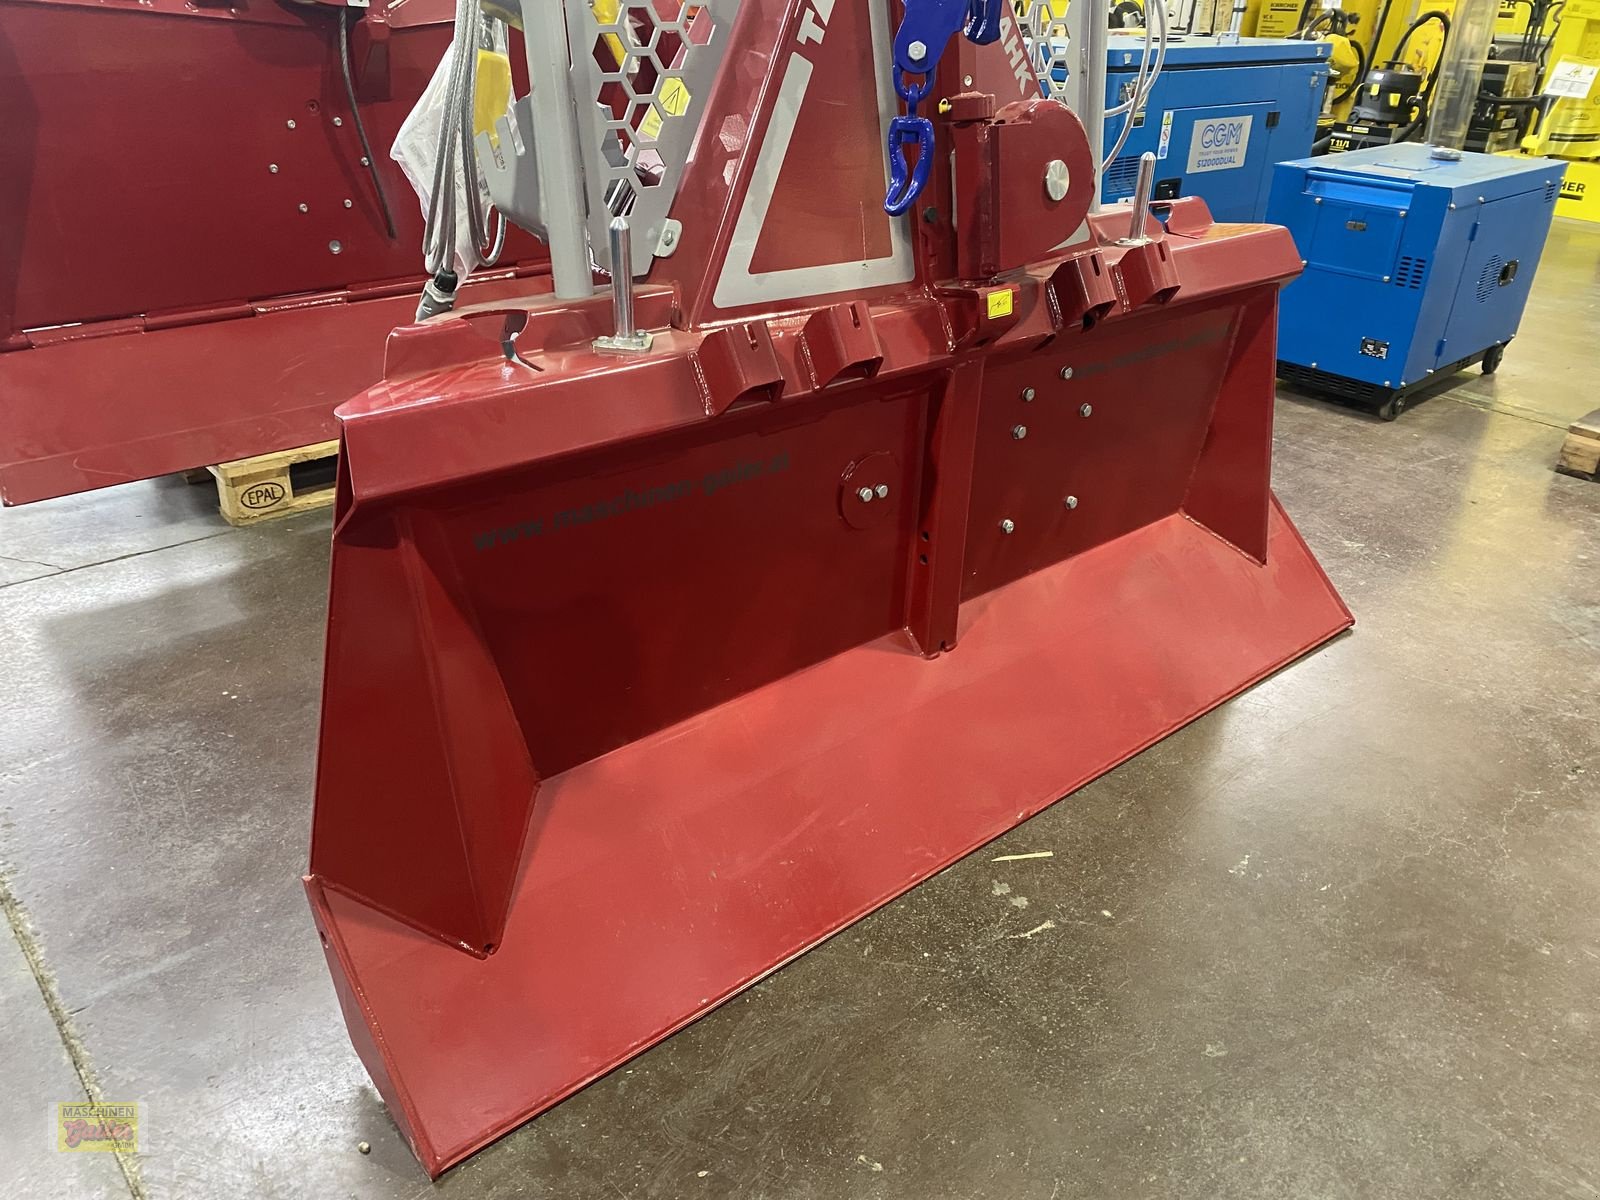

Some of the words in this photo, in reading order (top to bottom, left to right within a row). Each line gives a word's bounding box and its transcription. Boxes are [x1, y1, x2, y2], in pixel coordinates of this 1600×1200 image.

[999, 16, 1033, 95] AHK
[1202, 123, 1243, 148] CGM
[248, 487, 281, 505] EPAL
